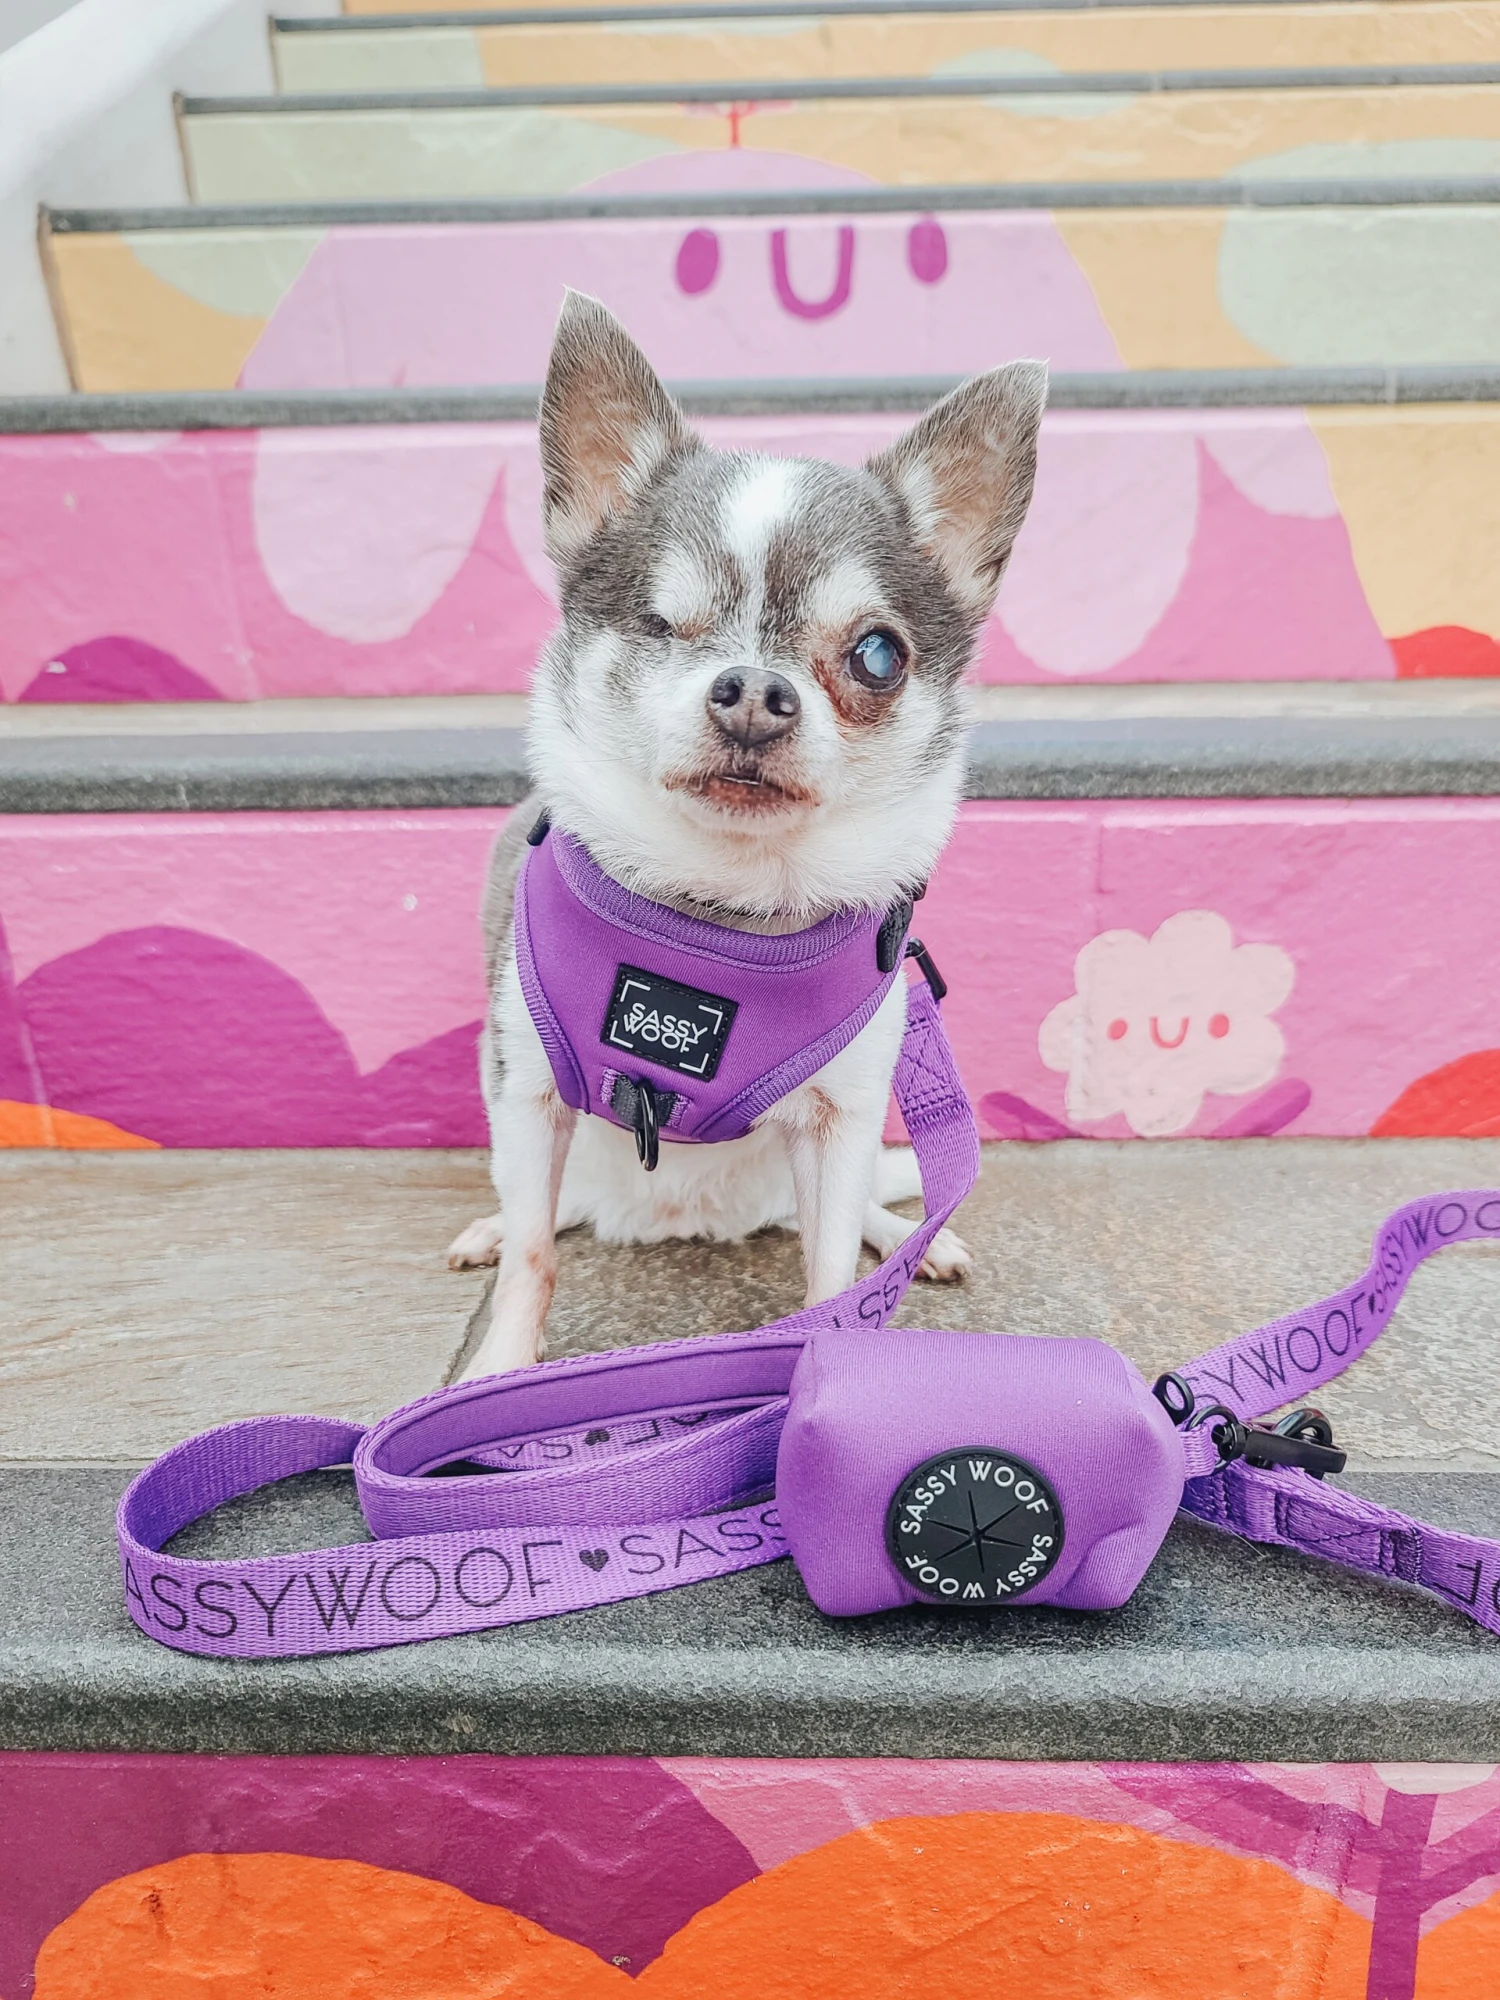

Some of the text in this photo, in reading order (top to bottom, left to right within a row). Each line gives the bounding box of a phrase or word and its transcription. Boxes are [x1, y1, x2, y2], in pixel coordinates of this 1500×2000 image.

[623, 1013, 699, 1053] WOOF
[631, 1002, 708, 1041] SASSY
[900, 1460, 1050, 1535] SASSY WOOF
[905, 1534, 1053, 1599] SASSY WOOF
